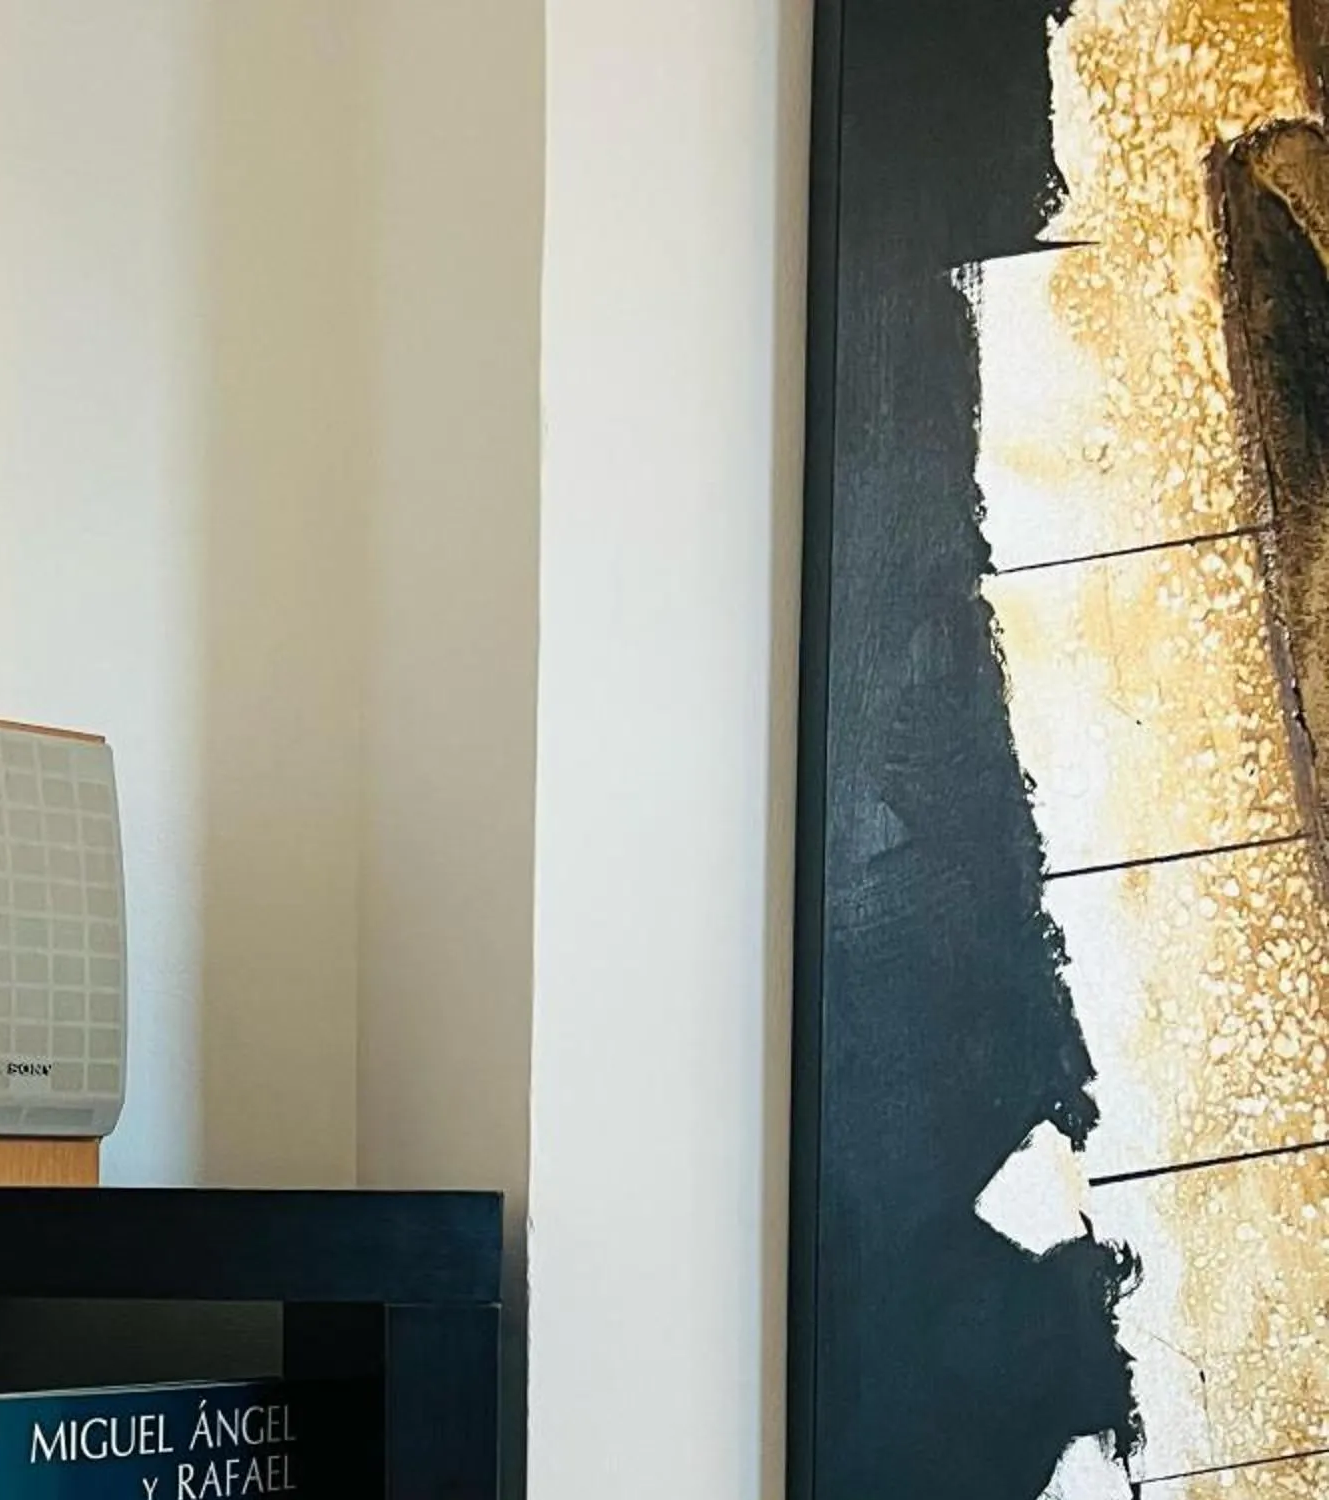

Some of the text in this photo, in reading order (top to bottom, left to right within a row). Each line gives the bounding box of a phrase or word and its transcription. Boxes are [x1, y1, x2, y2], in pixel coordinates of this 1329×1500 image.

[6, 1062, 52, 1076] SONY
[29, 1398, 297, 1464] MIGUEL ÁNGEL
